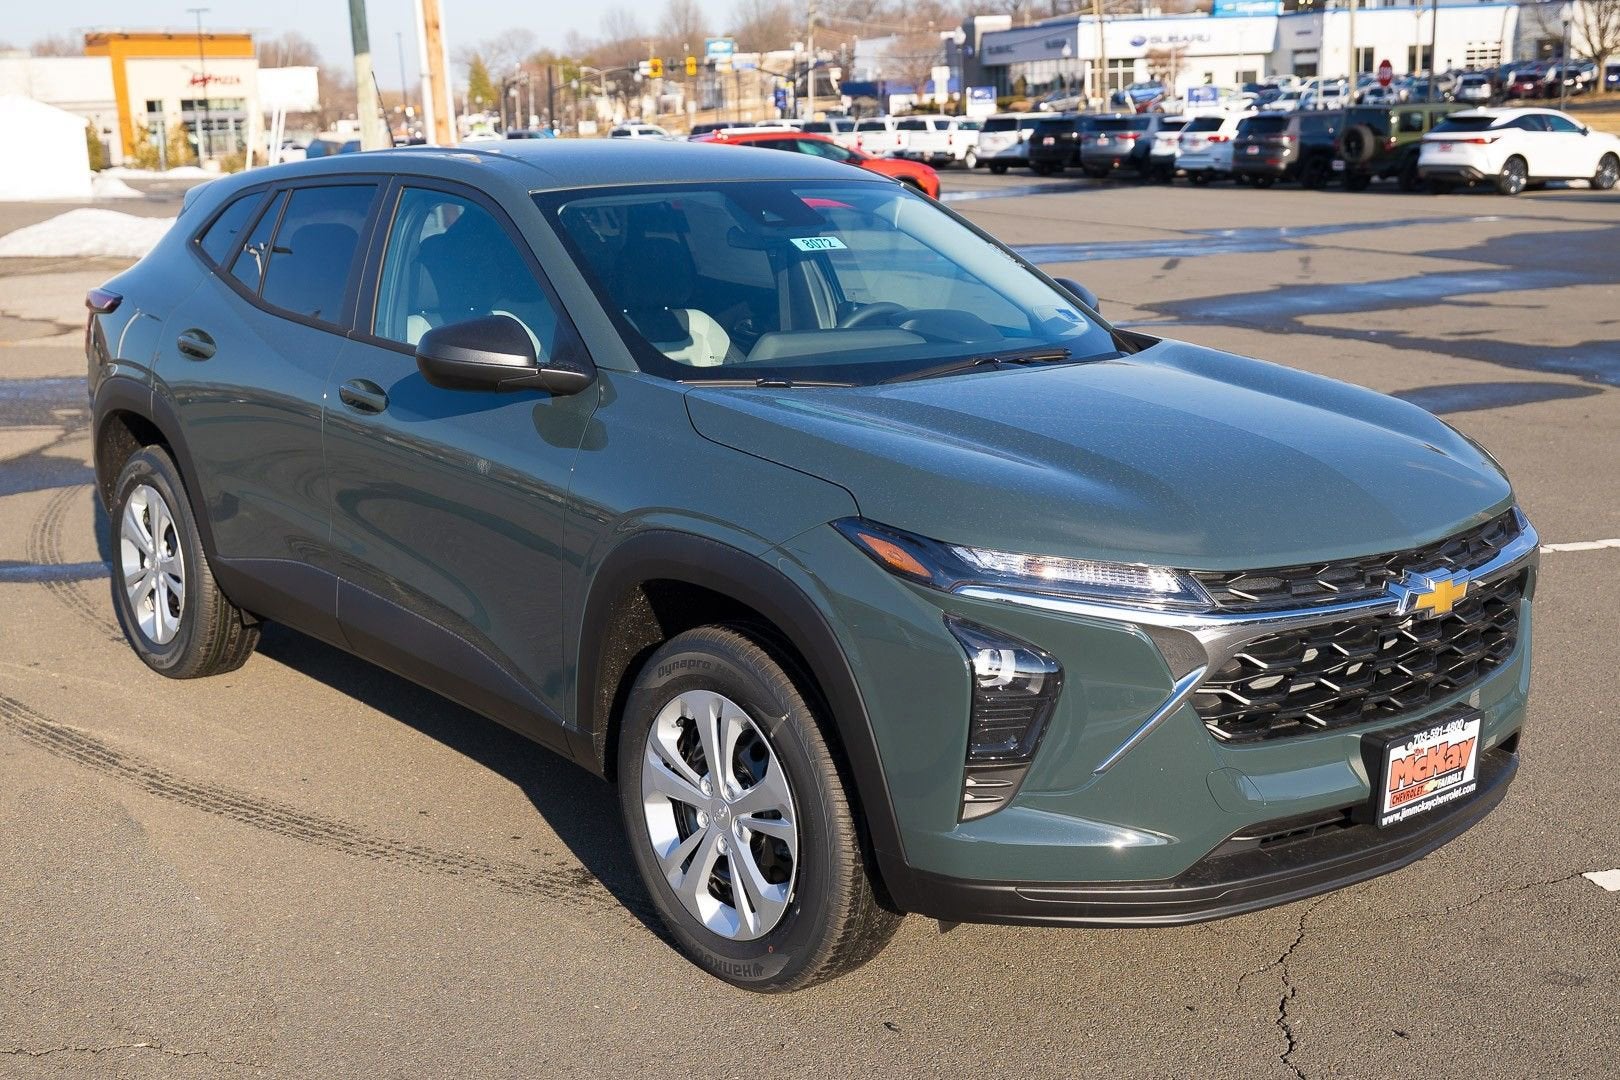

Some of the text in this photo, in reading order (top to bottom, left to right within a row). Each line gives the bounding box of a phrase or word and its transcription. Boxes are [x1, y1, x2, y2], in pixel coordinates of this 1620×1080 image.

[802, 238, 837, 249] 8072
[657, 659, 712, 678] Dynapro
[1413, 719, 1465, 746] 703-591-4800
[1389, 736, 1476, 792] McKay
[1381, 782, 1477, 827] www.jimmckaychevrolet.com
[1392, 785, 1424, 805] CHEVROLET
